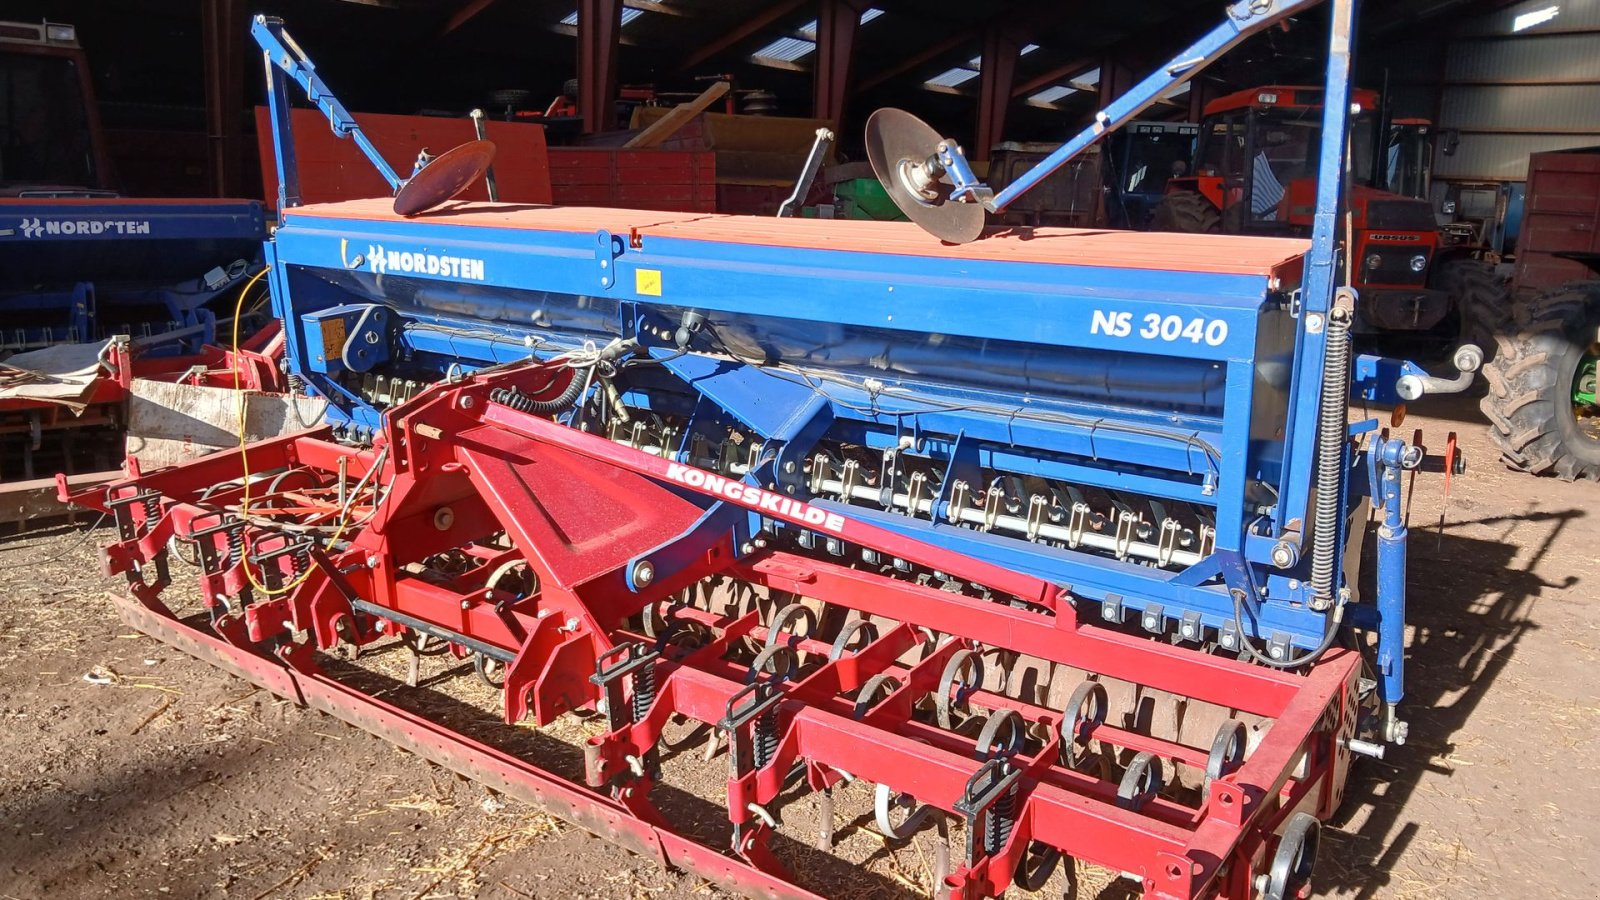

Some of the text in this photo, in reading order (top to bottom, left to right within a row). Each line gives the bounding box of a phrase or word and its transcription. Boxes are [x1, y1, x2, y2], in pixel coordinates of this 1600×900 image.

[387, 250, 485, 281] NORDSTEN
[1090, 309, 1229, 347] NS 3040
[666, 463, 846, 533] KONGSKILDE
